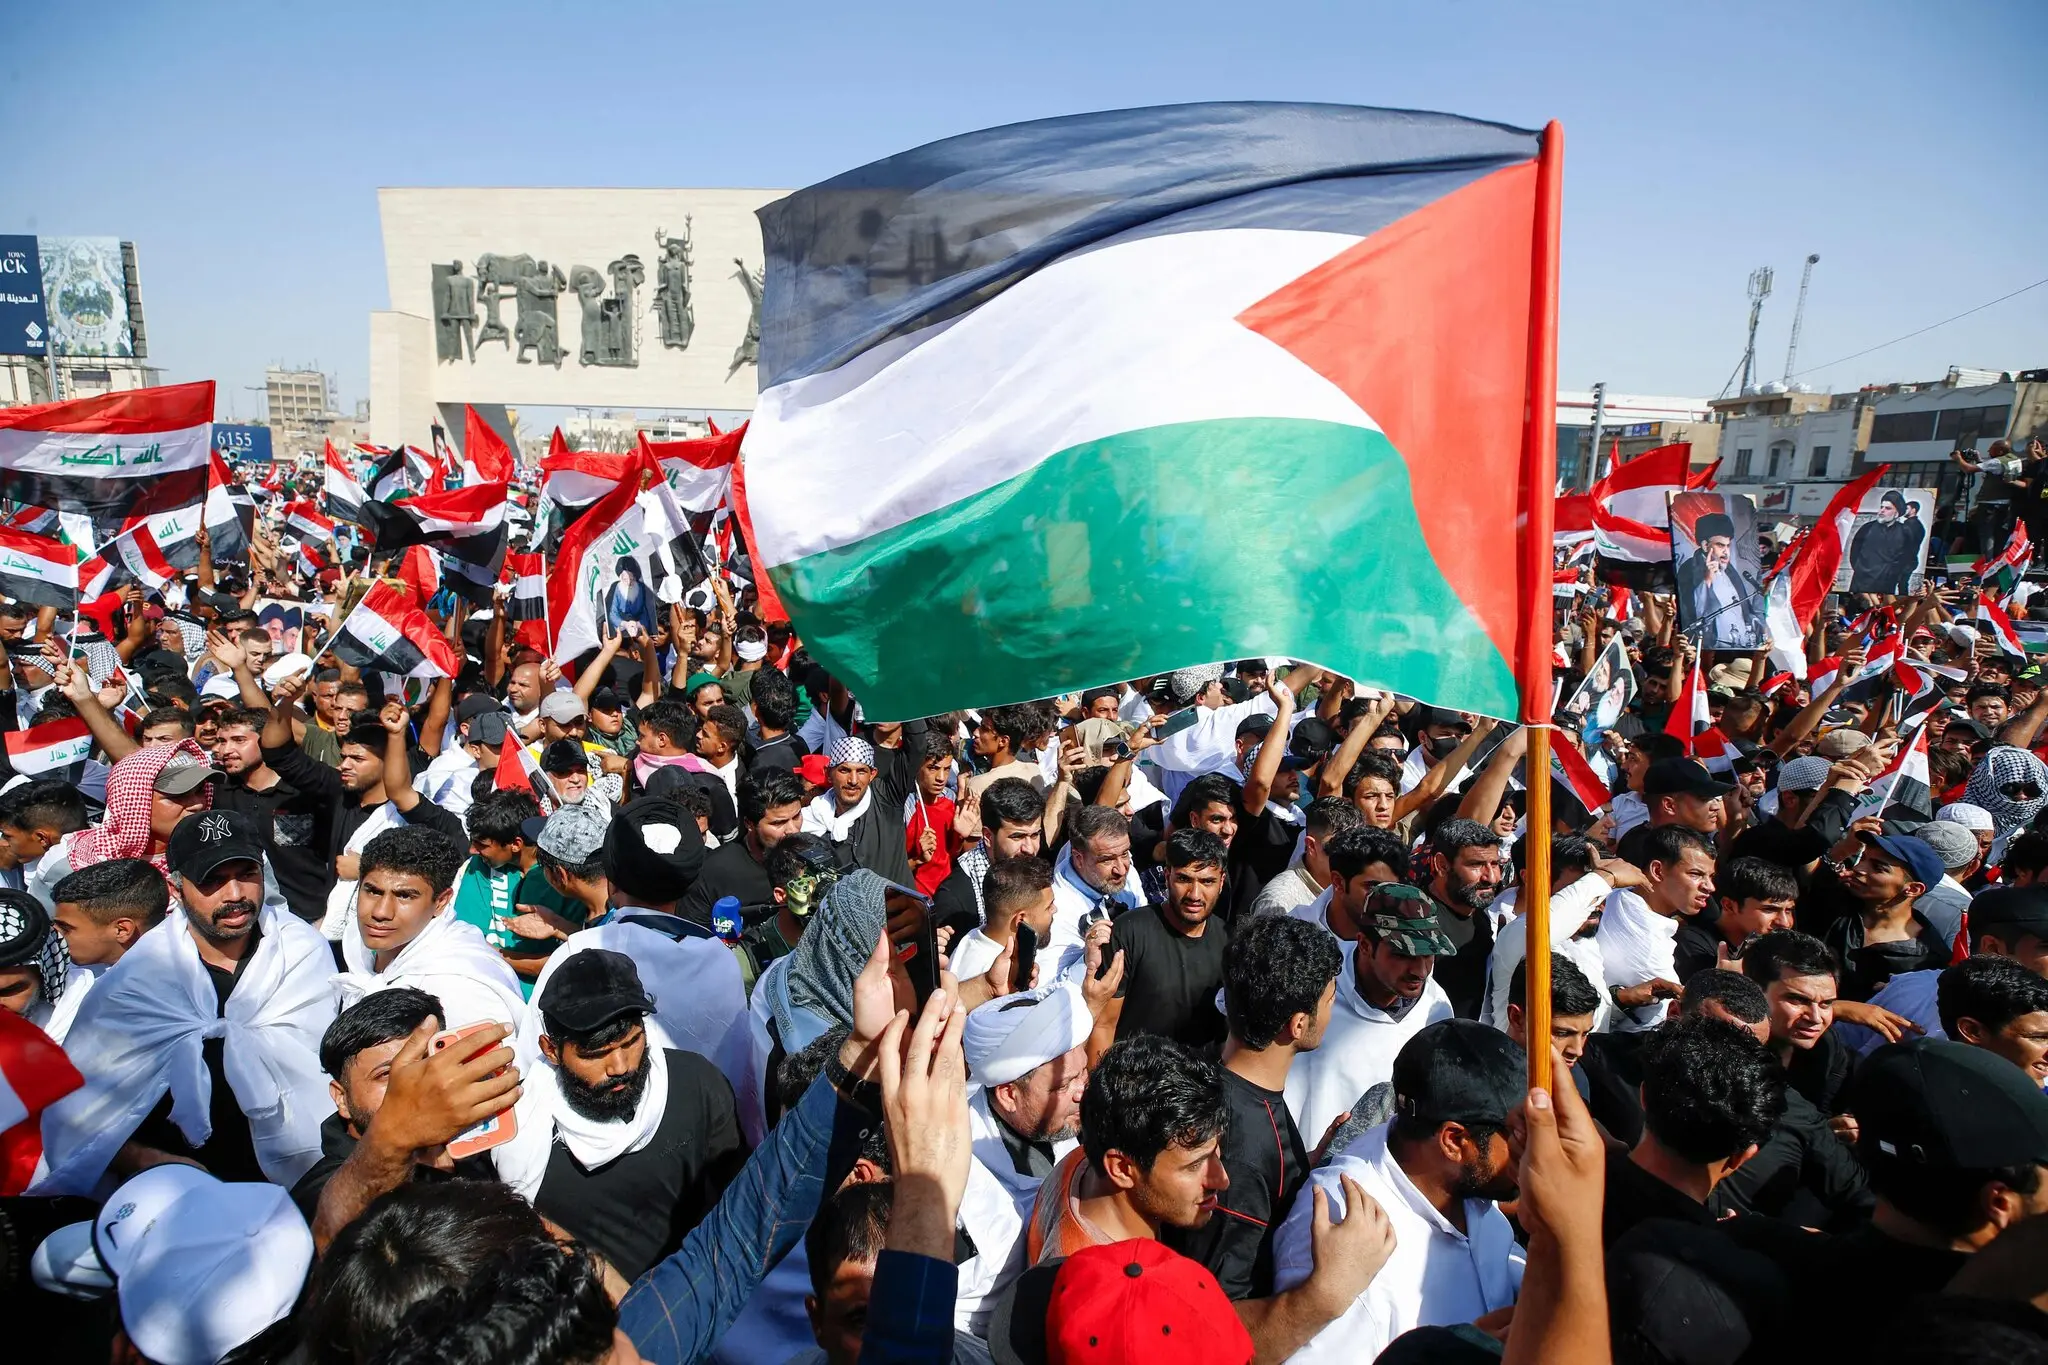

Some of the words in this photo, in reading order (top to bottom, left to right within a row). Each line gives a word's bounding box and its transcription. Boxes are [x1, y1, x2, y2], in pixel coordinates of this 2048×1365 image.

[217, 431, 252, 447] 6155
[132, 442, 163, 465] الله
[611, 528, 640, 556] الله
[199, 814, 232, 843] NY
